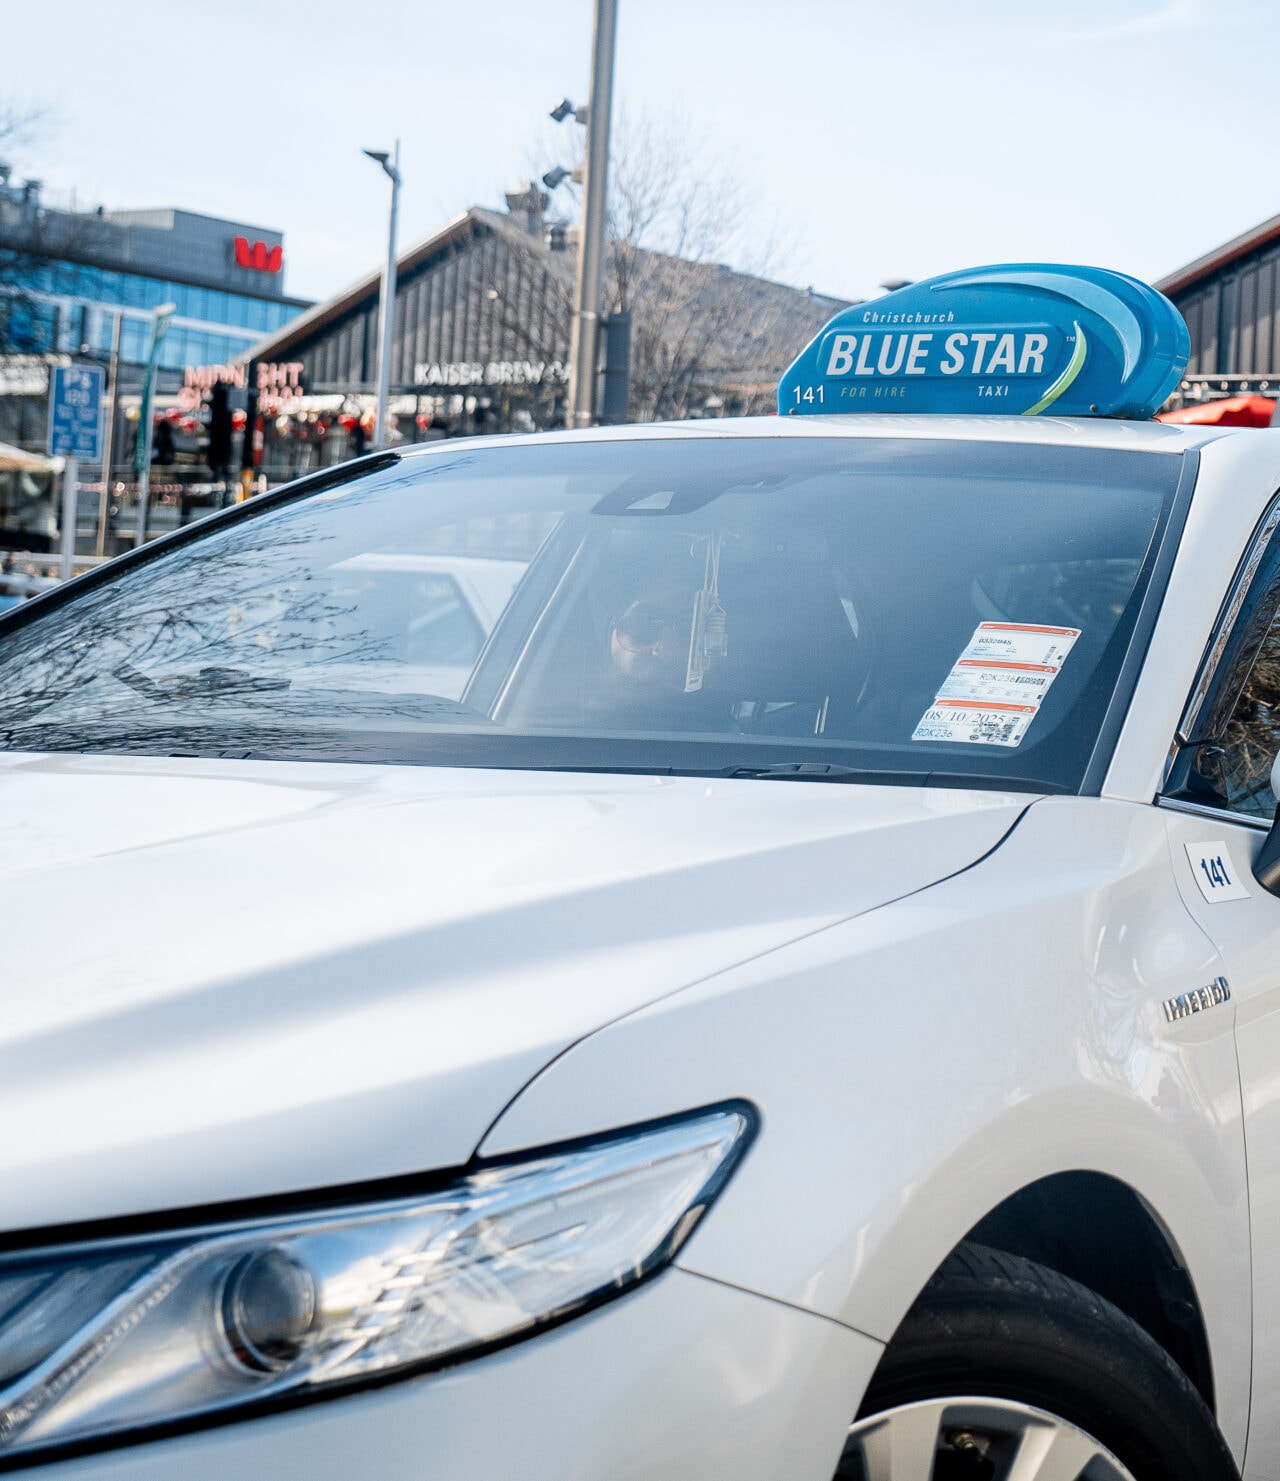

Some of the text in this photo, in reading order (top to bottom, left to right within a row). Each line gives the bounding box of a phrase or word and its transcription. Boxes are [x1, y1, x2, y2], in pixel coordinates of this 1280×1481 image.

[862, 311, 955, 323] Christchurch
[826, 333, 933, 376] BLUE
[940, 333, 1048, 374] STAR
[414, 361, 484, 386] KAISER
[793, 384, 825, 404] 141
[841, 386, 906, 398] FOR HIRE
[978, 385, 1009, 397] TAXI
[925, 709, 1005, 725] 08/10/2025
[1201, 856, 1232, 888] 141
